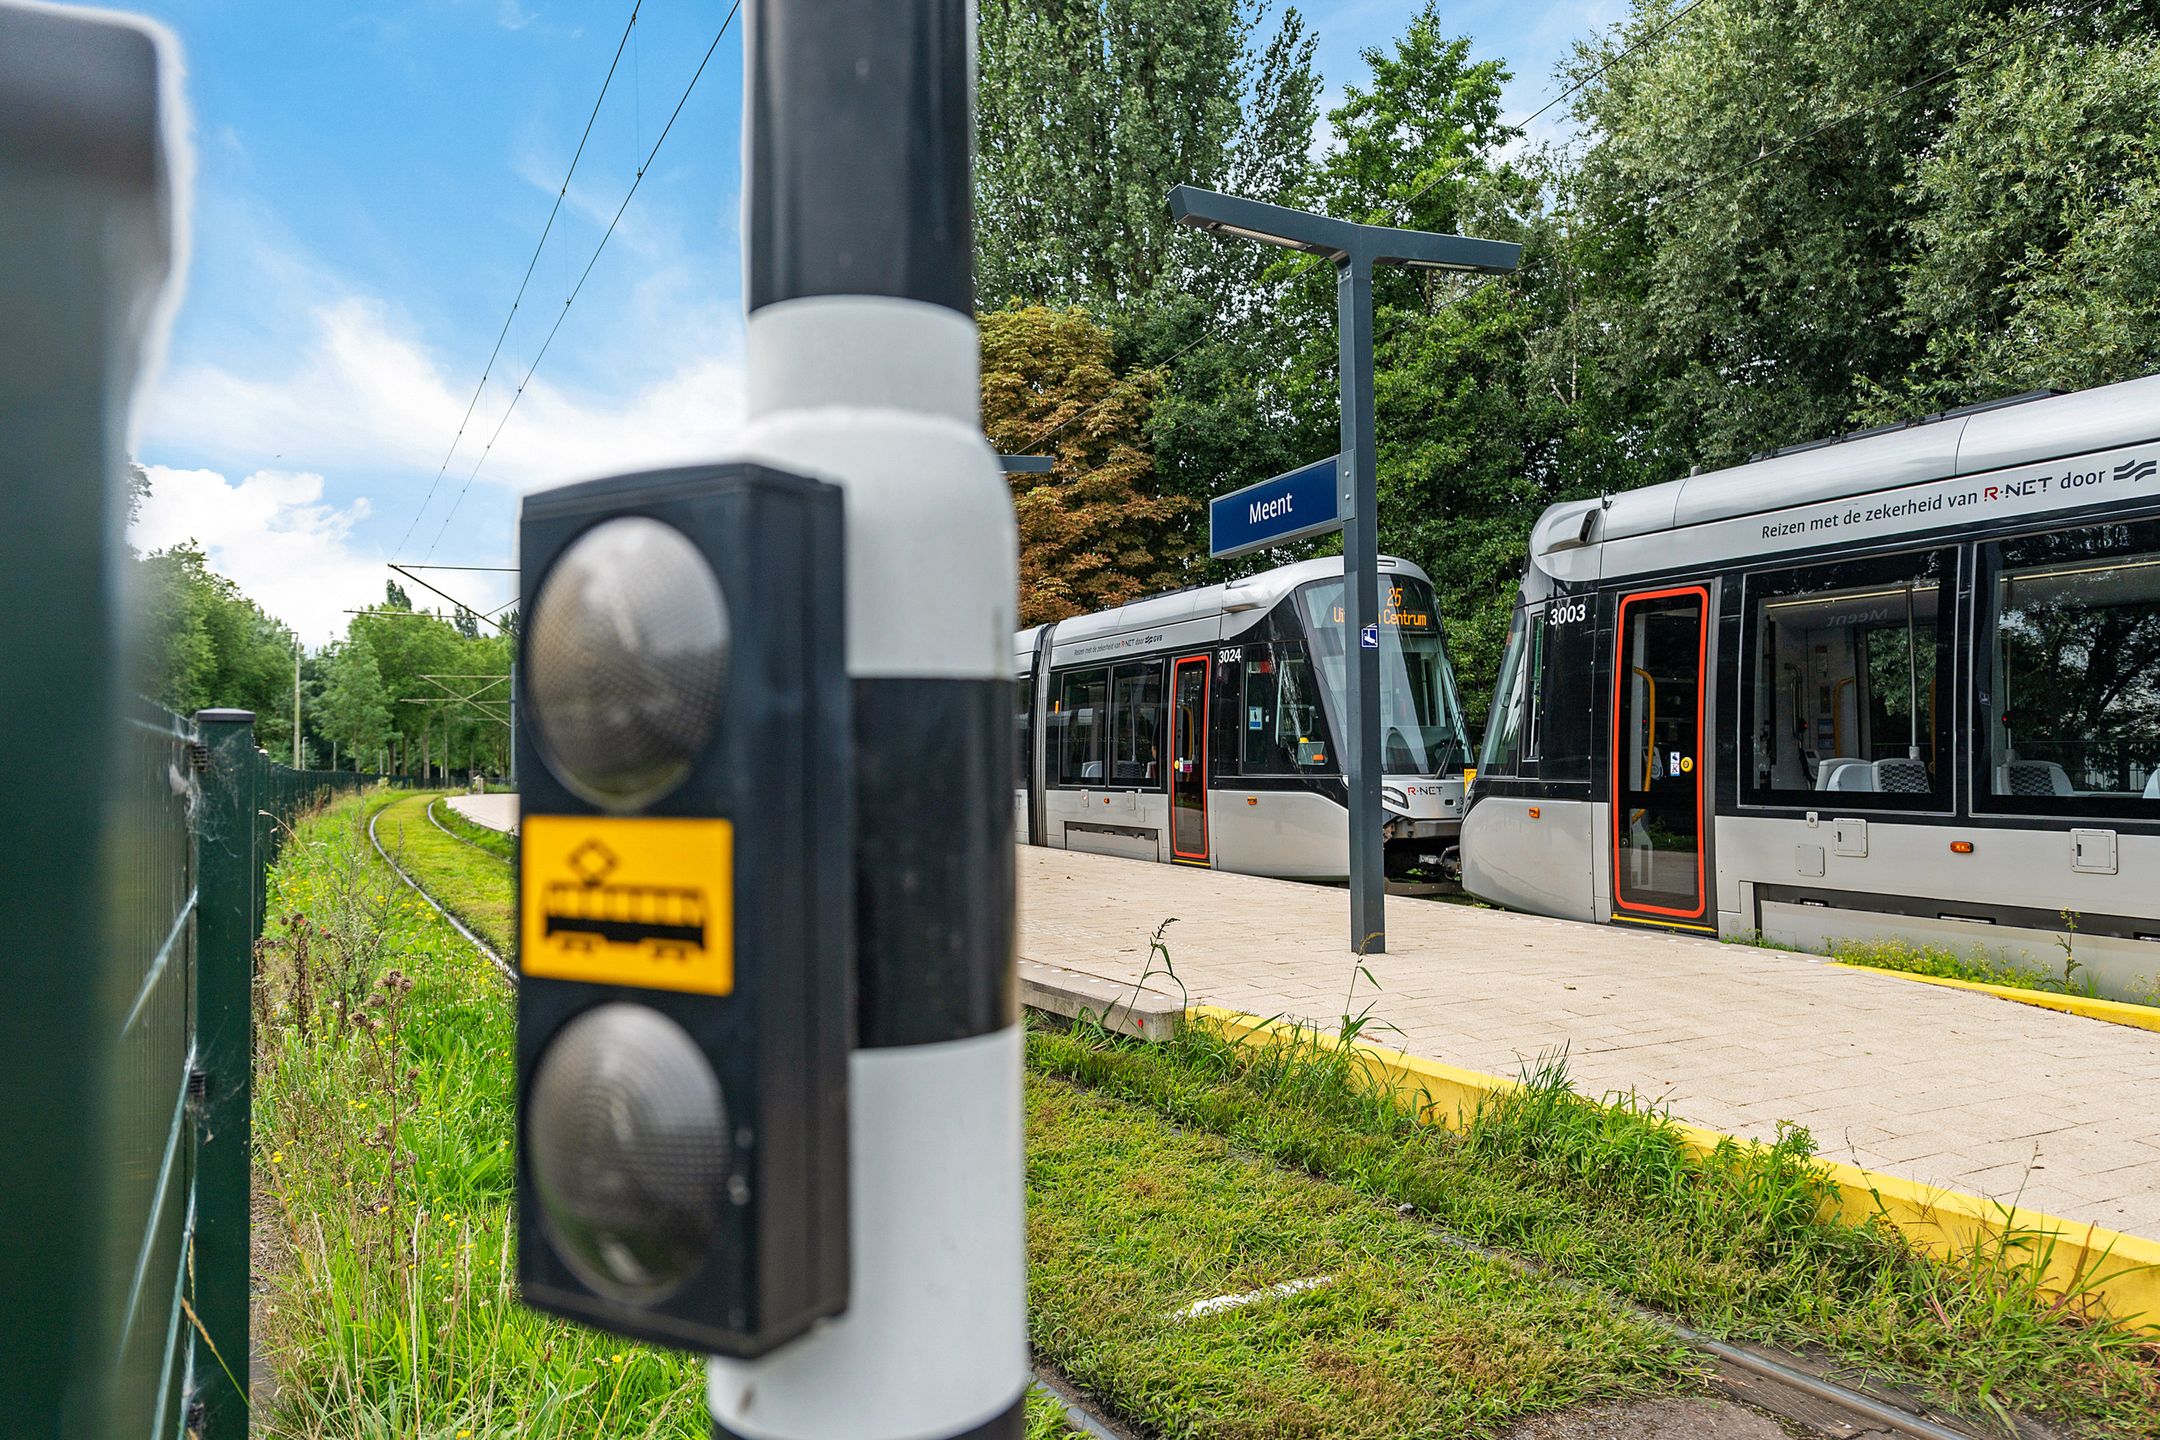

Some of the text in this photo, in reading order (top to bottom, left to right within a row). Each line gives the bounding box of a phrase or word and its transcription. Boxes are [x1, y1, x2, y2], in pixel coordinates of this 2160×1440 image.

[1249, 492, 1293, 525] Meent
[1762, 521, 1805, 539] Reizen
[1810, 514, 1839, 531] met
[1843, 510, 1861, 524] de
[1865, 493, 1942, 522] zekerheid
[1948, 492, 1977, 508] van
[2060, 471, 2106, 489] door
[1386, 587, 1403, 607] 25
[1383, 608, 1427, 626] Centrum
[1550, 604, 1586, 626] 3003
[1218, 648, 1241, 663] 3024
